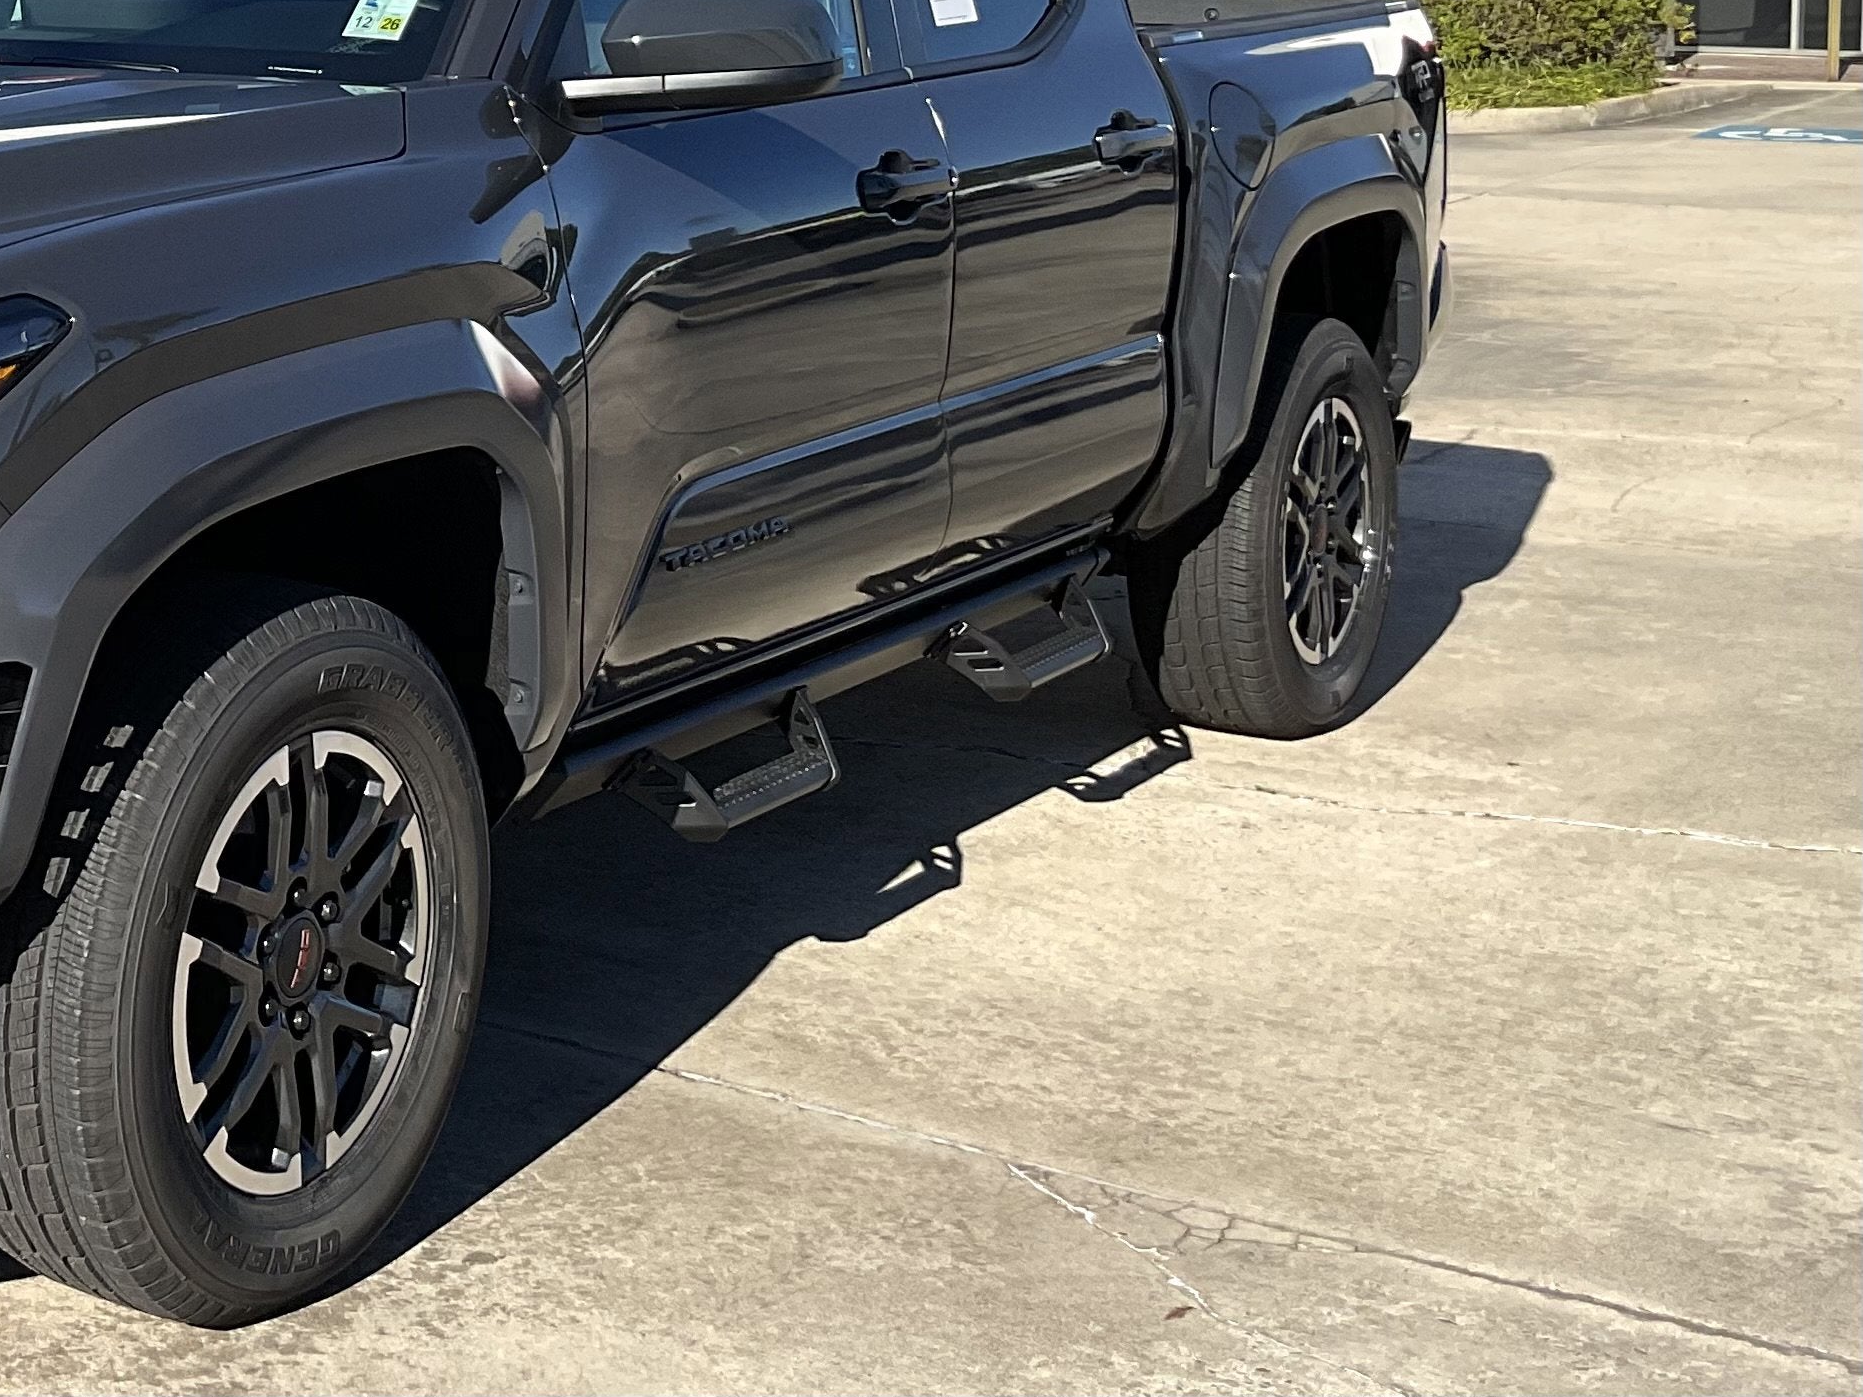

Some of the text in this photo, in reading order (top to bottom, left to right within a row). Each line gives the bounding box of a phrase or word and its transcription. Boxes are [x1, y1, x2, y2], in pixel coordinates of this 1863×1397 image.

[355, 15, 402, 31] 12 26
[658, 515, 793, 572] TACOMA
[317, 662, 455, 752] GRABBER
[189, 1204, 343, 1277] GENERAL
